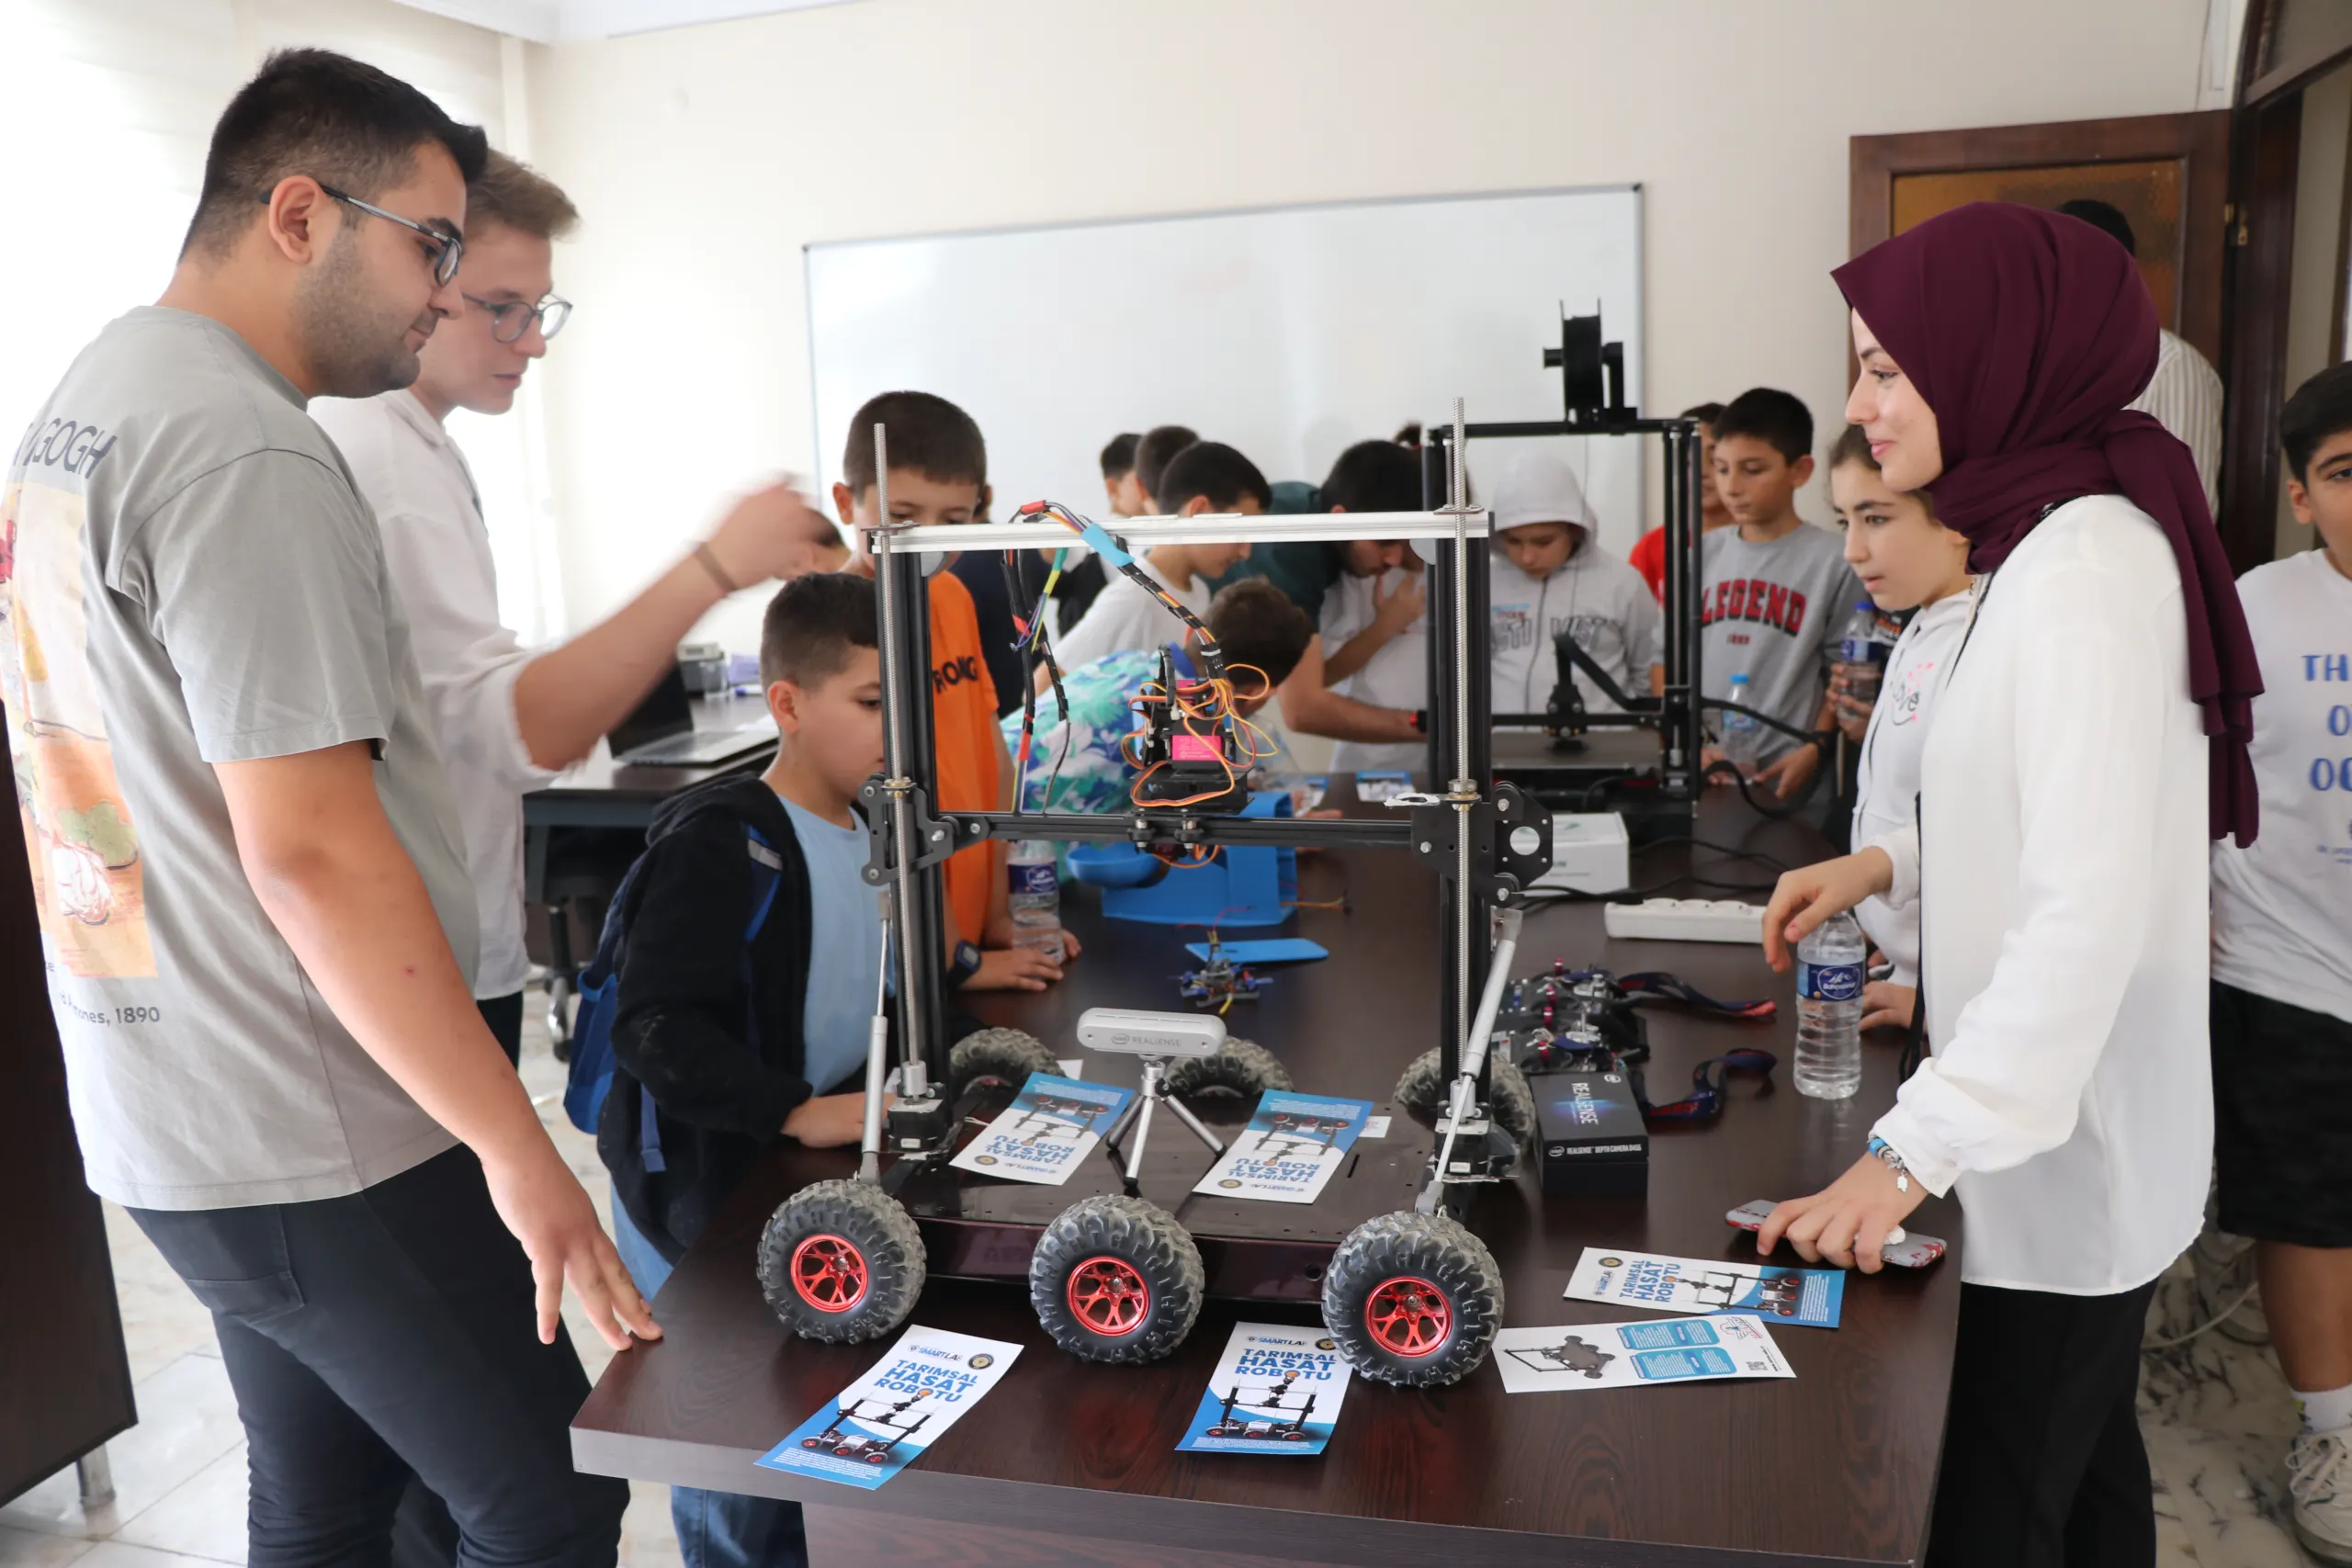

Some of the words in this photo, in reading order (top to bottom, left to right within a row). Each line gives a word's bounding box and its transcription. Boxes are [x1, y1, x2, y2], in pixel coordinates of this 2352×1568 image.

[1701, 578, 1807, 637] LEGEND
[115, 1006, 161, 1024] 1890
[1132, 1035, 1182, 1047] REALSENSE
[1571, 1082, 1599, 1125] REALSENSE
[988, 1141, 1070, 1160] HASAT
[1229, 1164, 1317, 1178] HASAT
[1619, 1260, 1645, 1298] TARIMSAL
[1634, 1261, 1664, 1301] HASAT
[1654, 1263, 1681, 1303] ROBOTU
[1238, 1355, 1336, 1371] HASAT
[1243, 1348, 1337, 1362] TARIMSAL
[884, 1367, 975, 1393] HASAT
[895, 1359, 978, 1384] TARIMSAL
[1234, 1365, 1332, 1381] ROBOTU
[873, 1377, 963, 1403] ROBOTU
